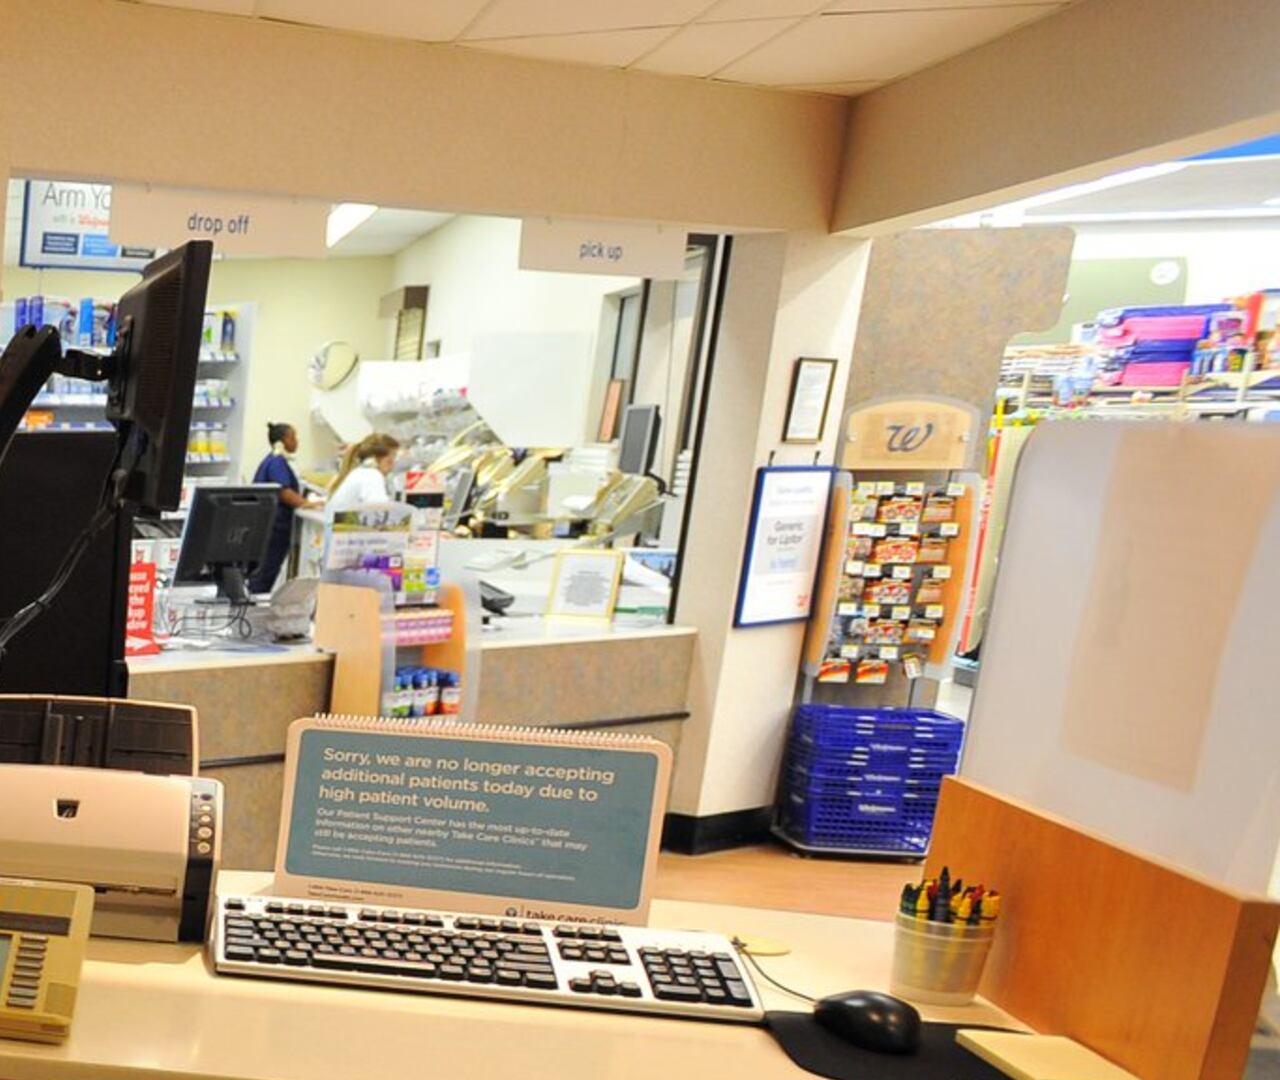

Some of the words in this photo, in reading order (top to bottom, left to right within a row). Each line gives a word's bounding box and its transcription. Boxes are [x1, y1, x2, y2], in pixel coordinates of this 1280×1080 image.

[42, 183, 86, 207] Arm
[187, 213, 223, 234] drop
[227, 215, 250, 234] off
[580, 241, 604, 259] pick
[607, 246, 623, 261] up
[323, 747, 371, 767] Sorry,
[376, 752, 400, 766] we
[404, 755, 432, 769] are
[436, 758, 460, 771] no
[463, 758, 521, 778] longer
[524, 763, 615, 785] accepting
[321, 767, 405, 786] additional
[409, 774, 479, 794] patients
[483, 779, 534, 798] today
[539, 783, 573, 800] due
[578, 787, 599, 802] to
[319, 785, 355, 803] high
[358, 788, 418, 807] patient
[423, 794, 490, 813] volume.
[316, 807, 336, 817] Our
[336, 809, 371, 820] Patient
[372, 811, 412, 824] Support
[414, 816, 447, 827] Center
[448, 819, 467, 829] has
[468, 820, 486, 831] the
[486, 823, 512, 833] most
[514, 826, 571, 838] up-to-date
[314, 828, 332, 838] still
[332, 829, 345, 840] be
[347, 832, 394, 845] accepting
[396, 836, 437, 848] patients.
[371, 823, 385, 832] on
[386, 824, 414, 834] other
[414, 827, 450, 839] nearby
[452, 830, 474, 841] Take
[476, 832, 500, 842] Care
[541, 839, 562, 849] that
[563, 841, 589, 852] may
[526, 908, 555, 920] take
[557, 913, 588, 924] care
